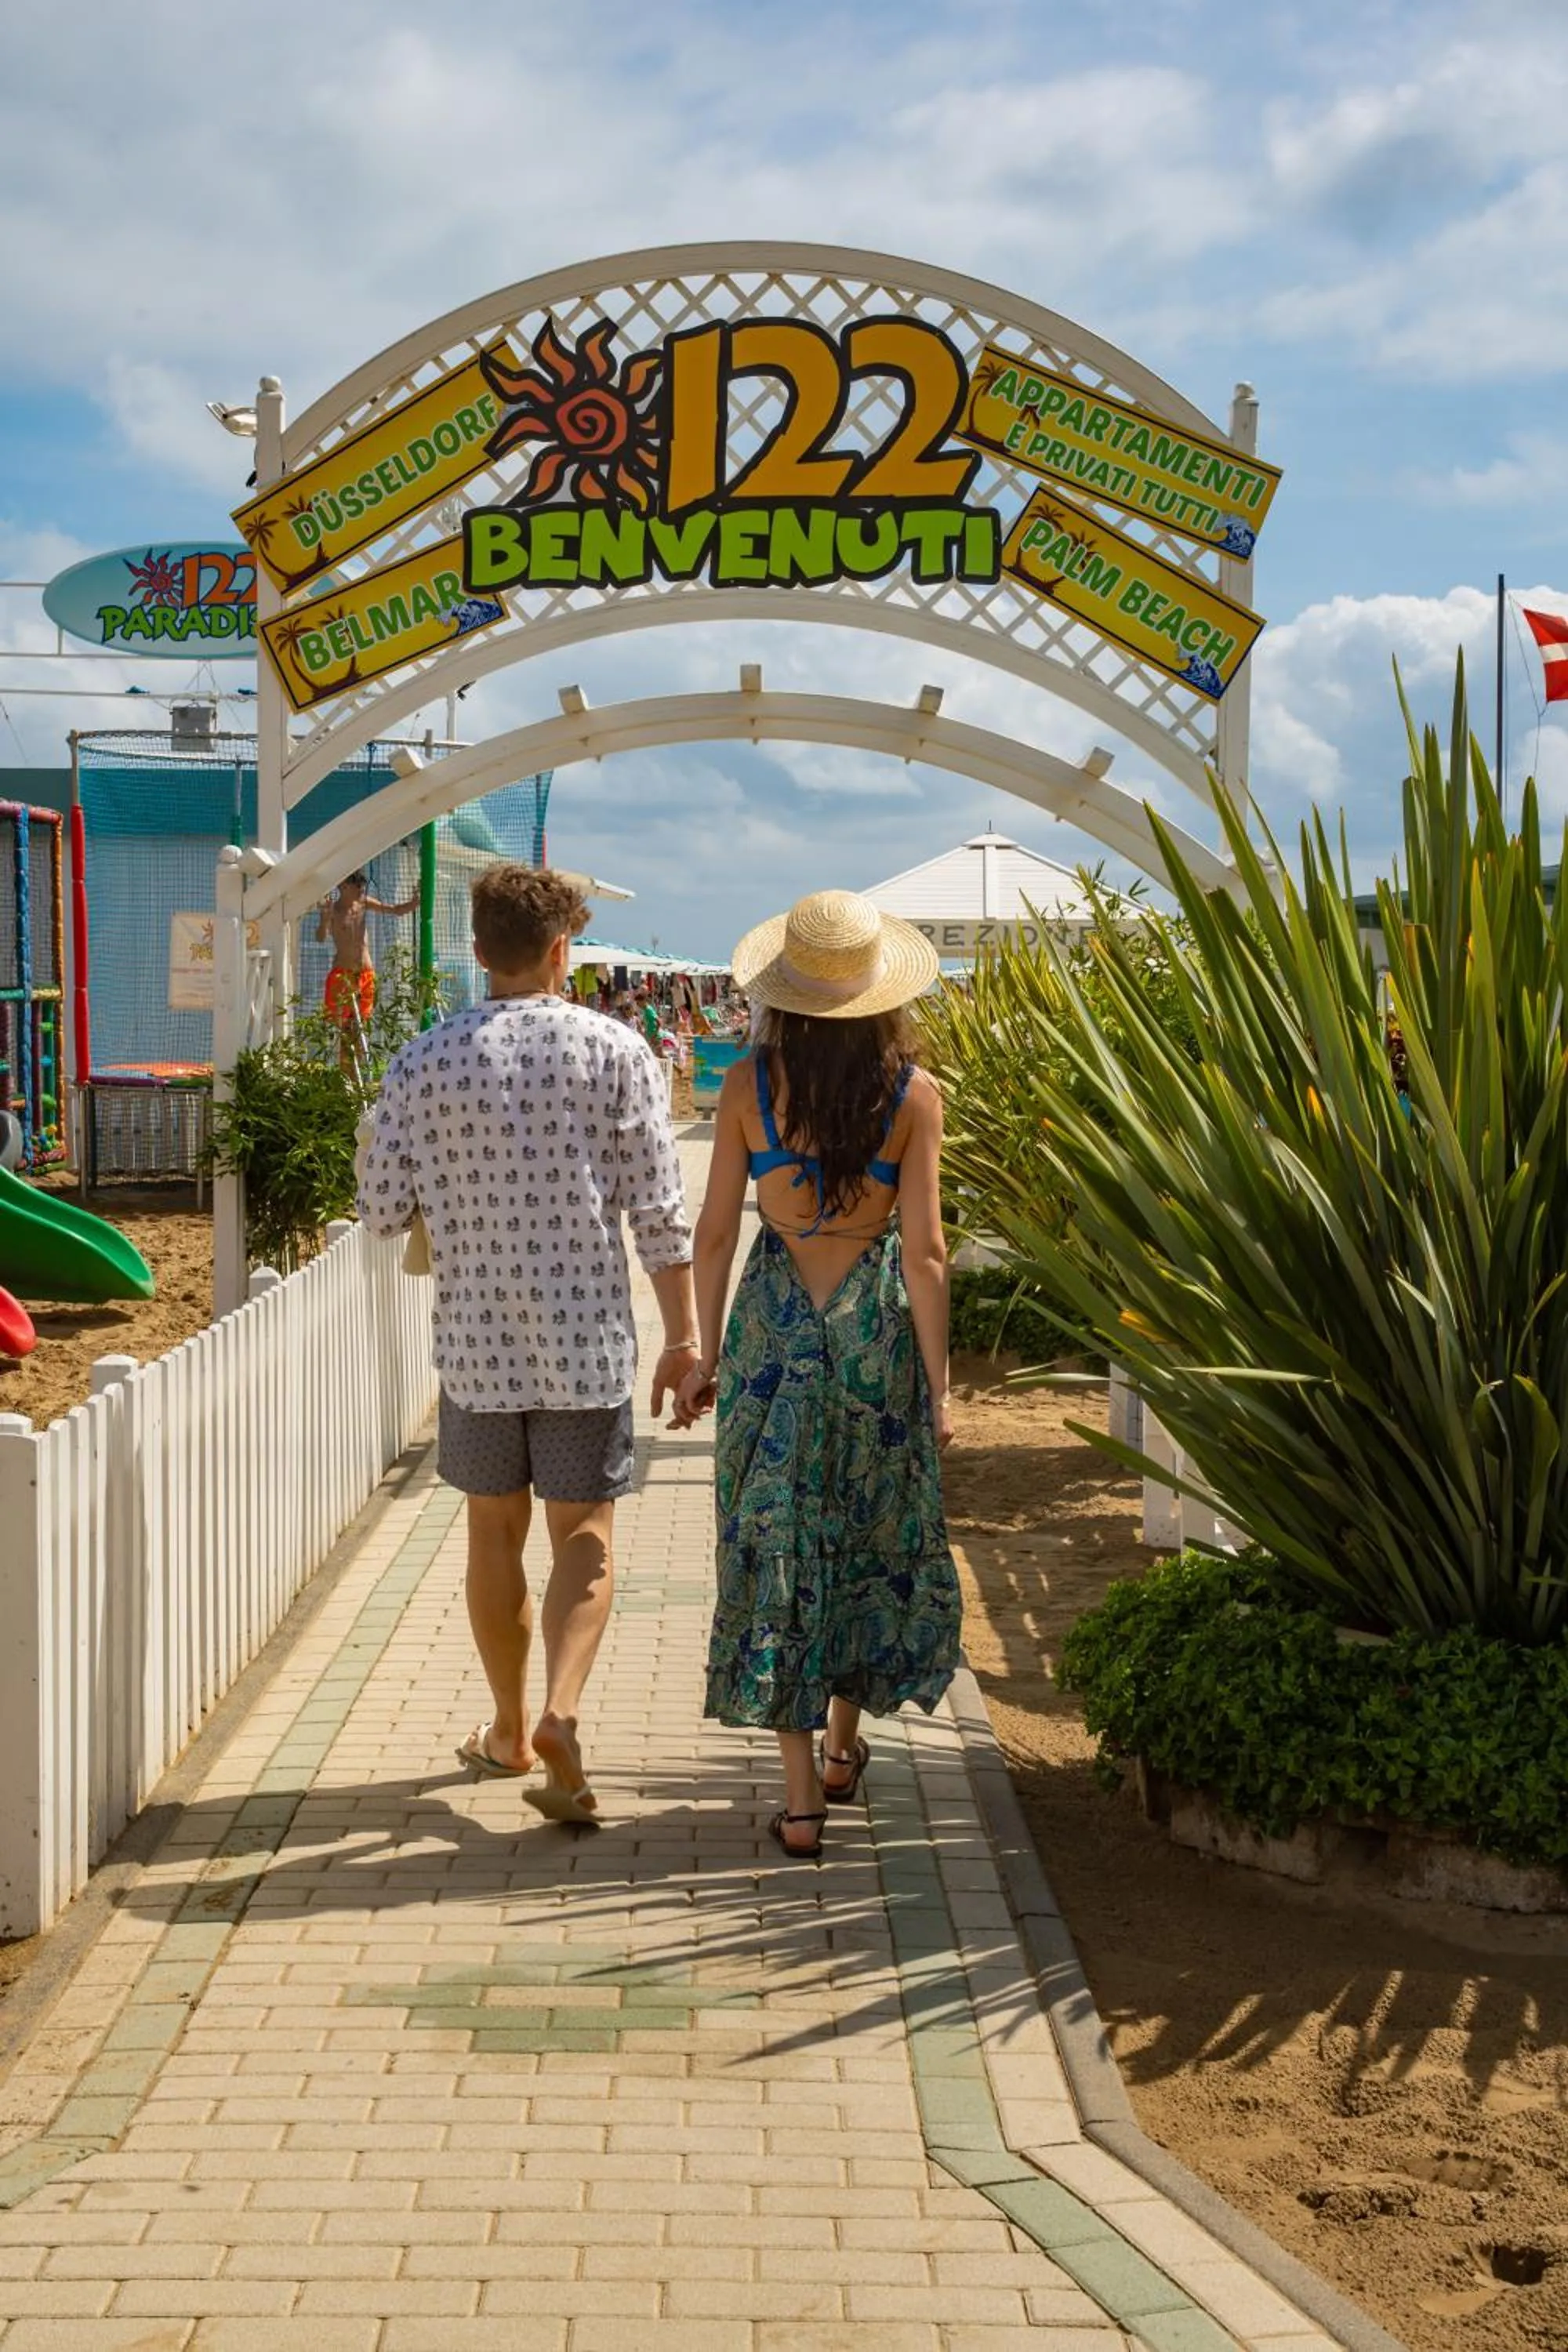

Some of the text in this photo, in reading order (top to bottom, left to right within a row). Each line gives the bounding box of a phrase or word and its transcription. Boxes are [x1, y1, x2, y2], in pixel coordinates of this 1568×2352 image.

[289, 393, 500, 549] DÜSSELDORF
[663, 315, 982, 521] 122
[989, 368, 1268, 510] APPARTAMENTI
[1004, 421, 1220, 534] E PRIVATI TUTTI
[463, 502, 1000, 593] BENVENUTI
[1020, 518, 1236, 669] PALM BEACH
[297, 570, 467, 673] BELMAR
